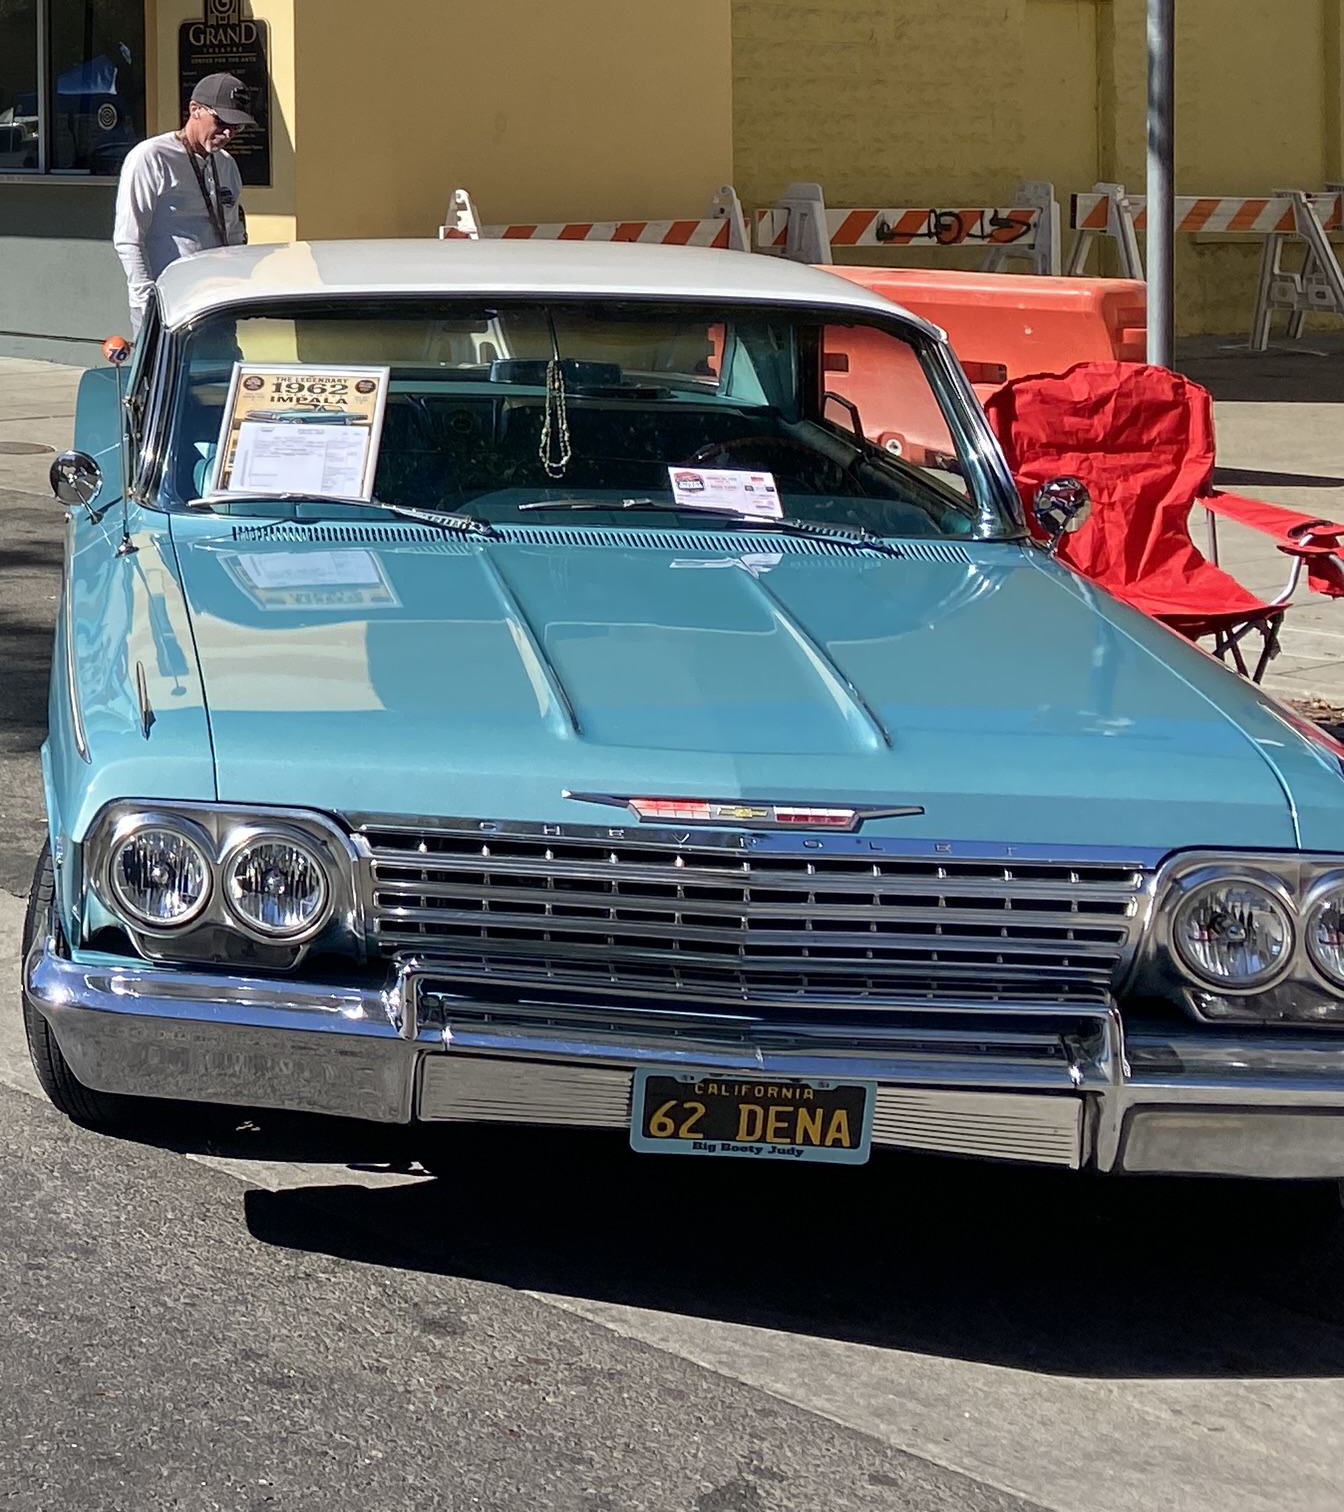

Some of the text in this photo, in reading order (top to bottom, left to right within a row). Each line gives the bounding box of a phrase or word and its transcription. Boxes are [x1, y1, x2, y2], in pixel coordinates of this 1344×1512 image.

[189, 22, 257, 46] GRAND
[108, 347, 128, 361] 76
[271, 382, 349, 395] 1962
[270, 396, 348, 405] IMPALA
[694, 1083, 814, 1100] CALIFORNIA
[649, 1100, 851, 1147] 62 DENA
[692, 1141, 804, 1158] Big Booty Judy
